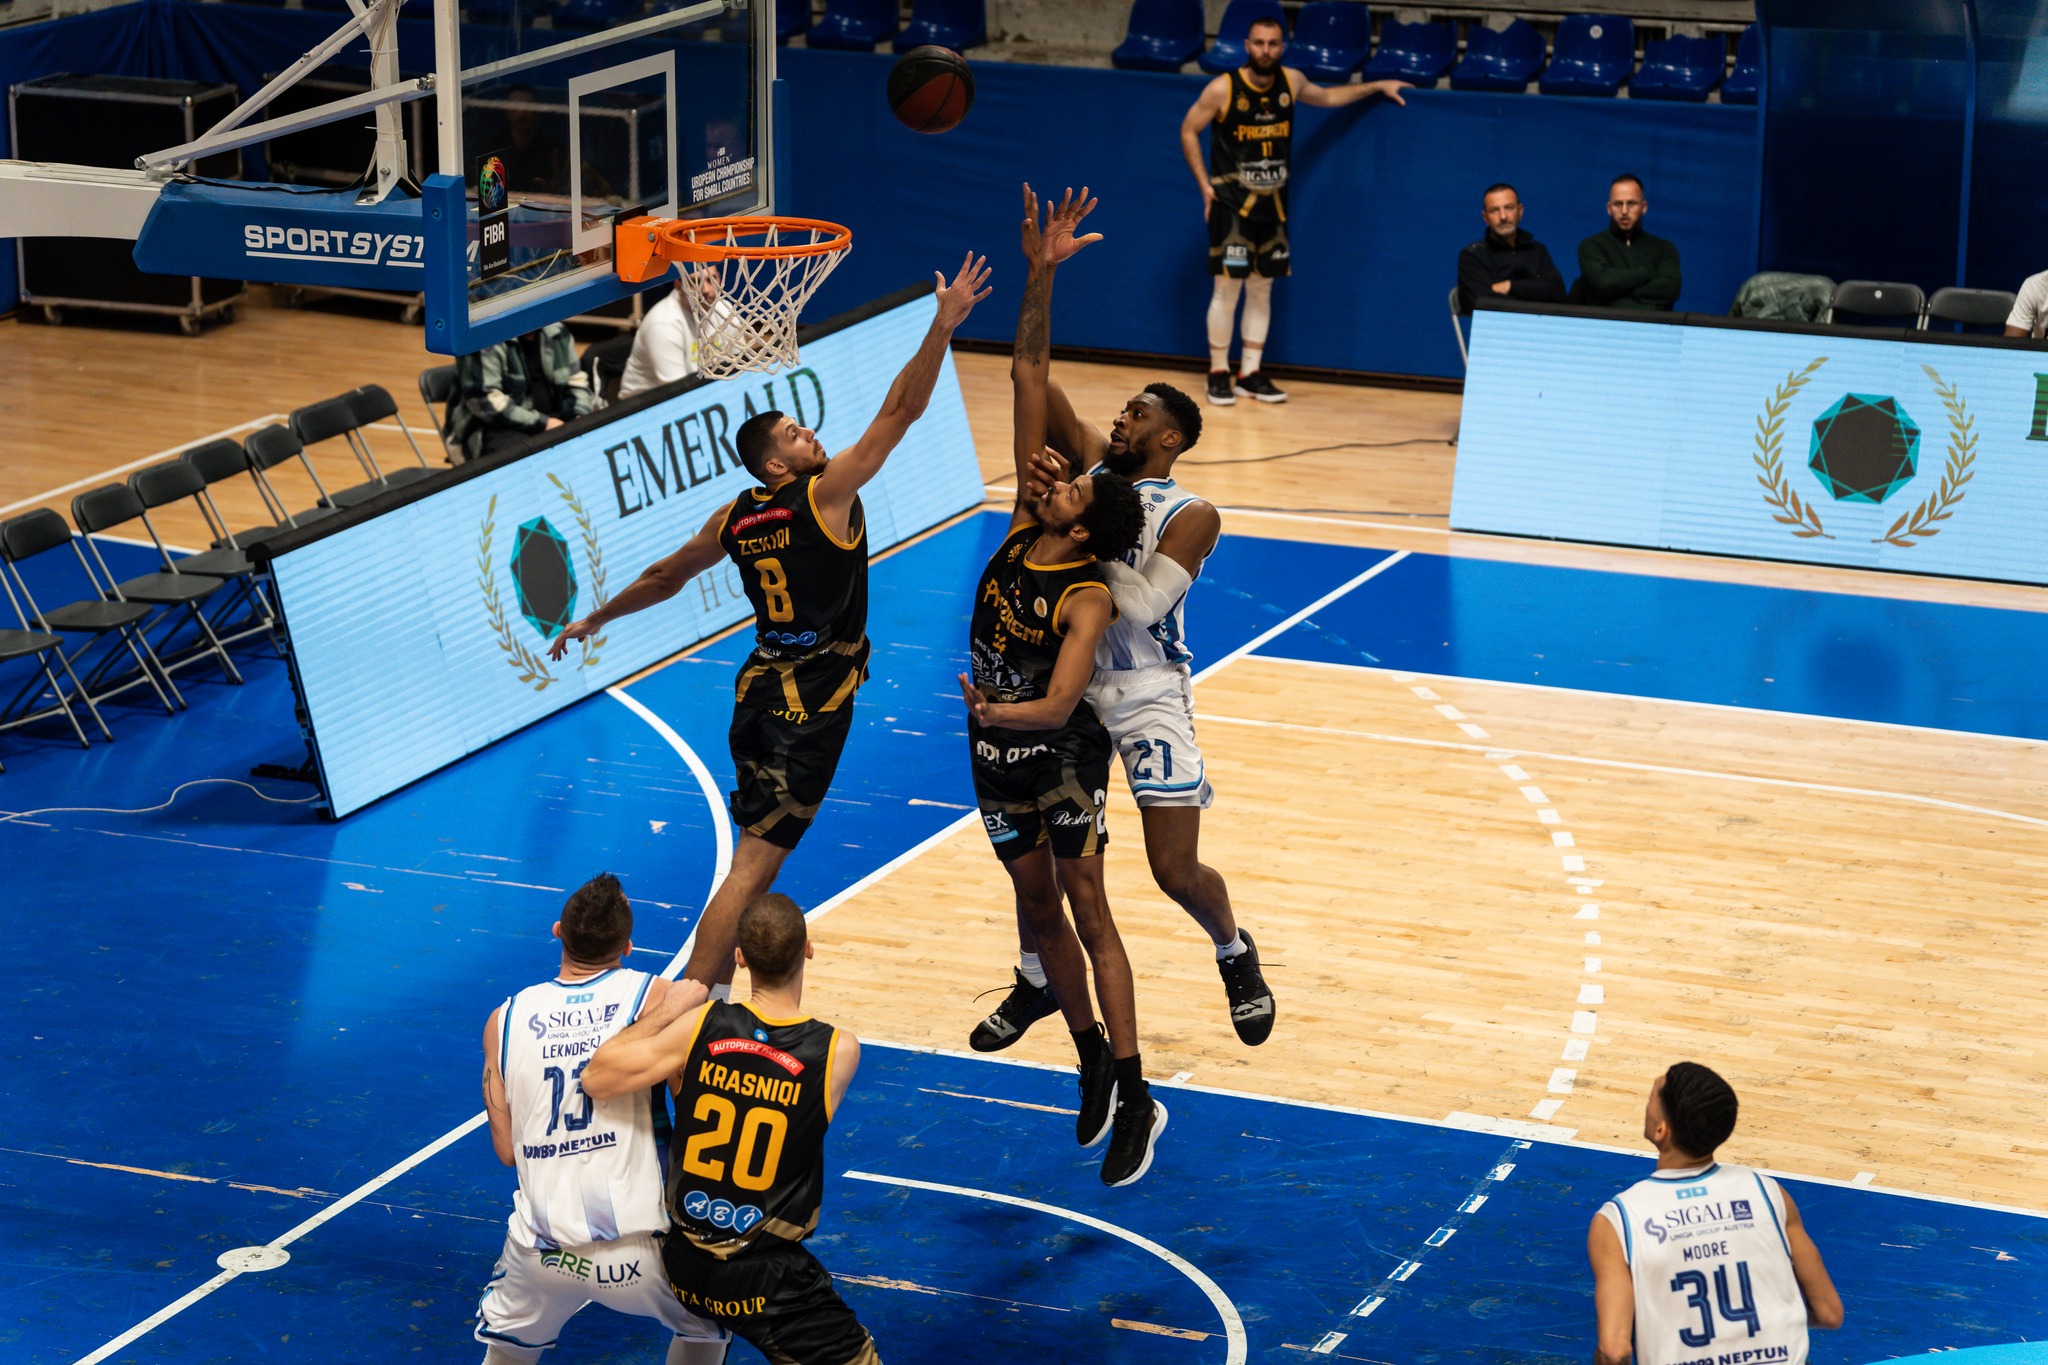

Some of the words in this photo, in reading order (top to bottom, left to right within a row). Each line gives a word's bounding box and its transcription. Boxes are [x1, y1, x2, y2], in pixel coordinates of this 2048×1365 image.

[716, 157, 755, 181] CHAMPIONSHIP
[693, 188, 704, 203] FOR
[704, 180, 722, 200] SMALL
[721, 172, 751, 194] COUNTRIES
[483, 221, 506, 247] FIBA
[753, 557, 795, 622] 8
[1132, 738, 1173, 780] 21
[761, 1047, 799, 1071] PARTNER
[698, 1060, 802, 1107] KRASNIQI
[558, 1132, 617, 1154] NEPTUN
[683, 1093, 788, 1191] 20
[1664, 1202, 1731, 1228] SIGAL
[1669, 1231, 1694, 1242] UNIQA
[1682, 1240, 1730, 1262] MOORE
[596, 1260, 642, 1284] LUX
[704, 1296, 766, 1317] GROUP
[1670, 1261, 1761, 1348] 34
[1717, 1345, 1789, 1365] NEPTUN
